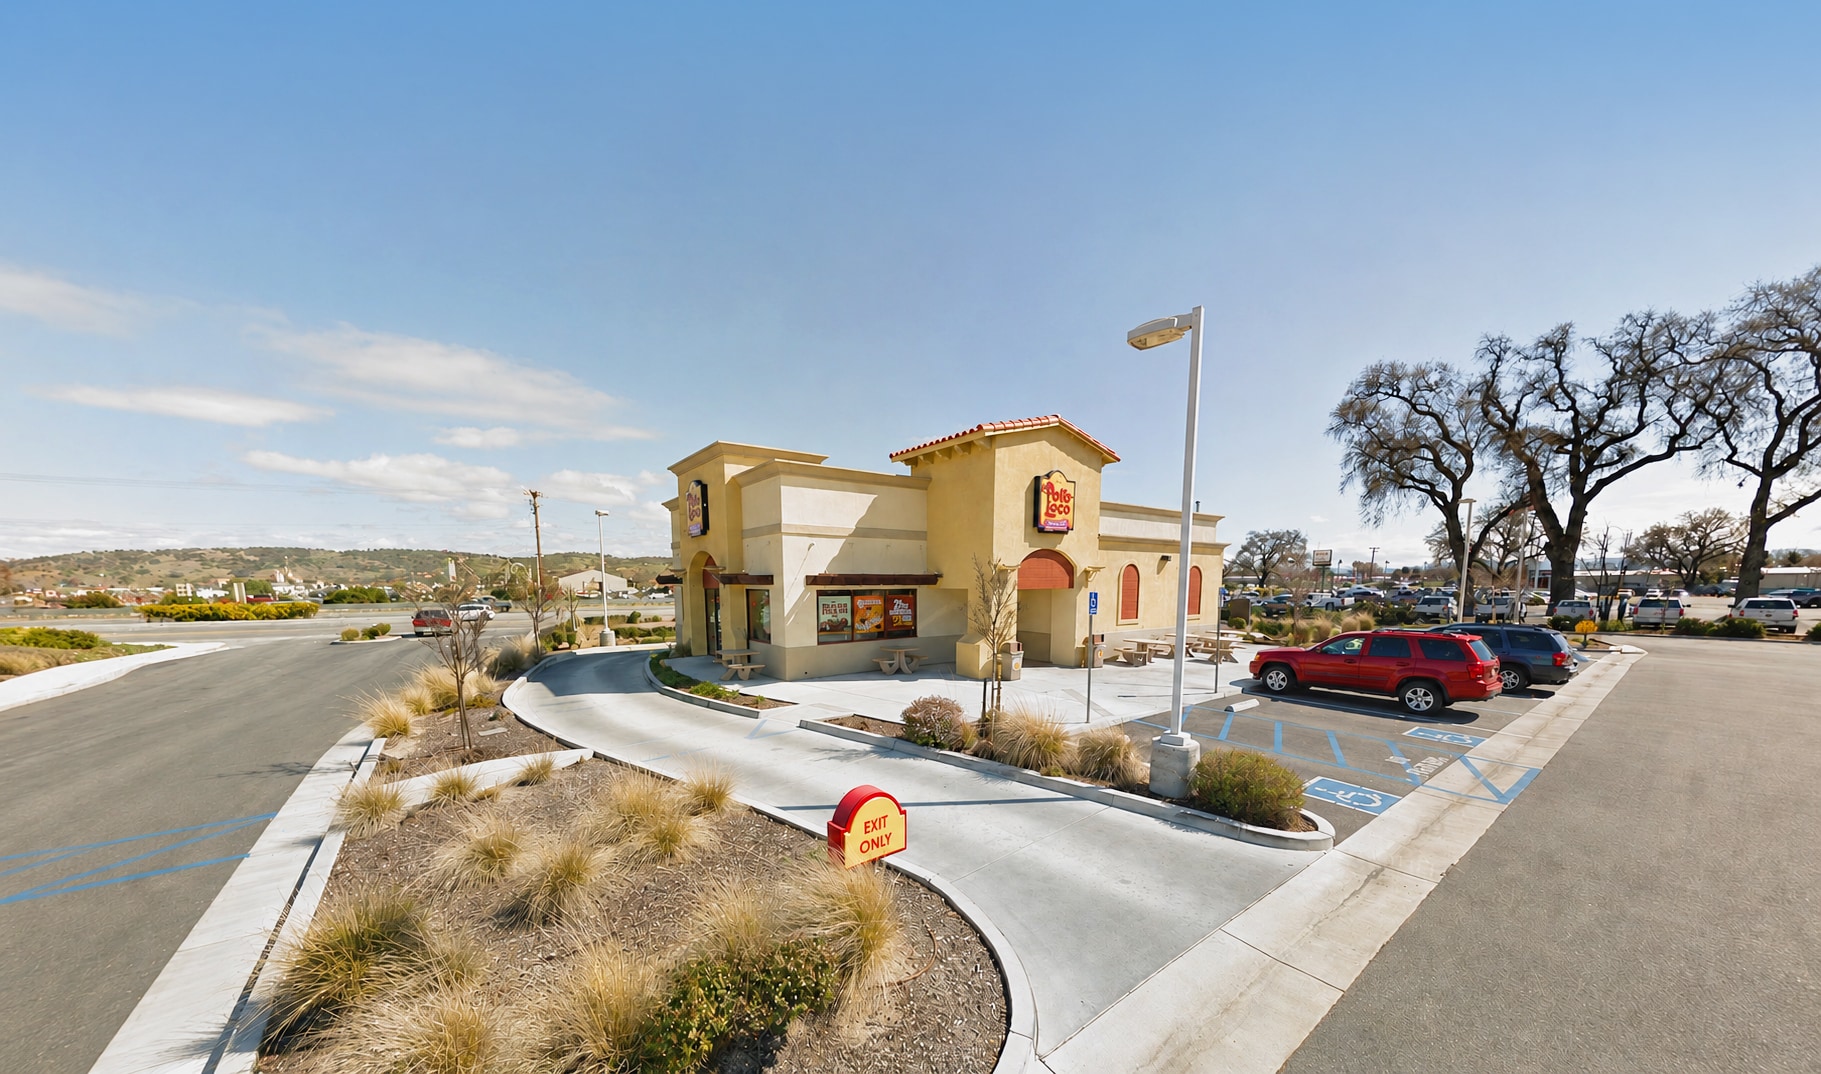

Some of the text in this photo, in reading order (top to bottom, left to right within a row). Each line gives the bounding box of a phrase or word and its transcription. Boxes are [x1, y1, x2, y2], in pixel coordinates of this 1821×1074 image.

[1044, 501, 1070, 518] Loco
[864, 815, 888, 834] EXIT
[859, 832, 892, 854] ONLY
